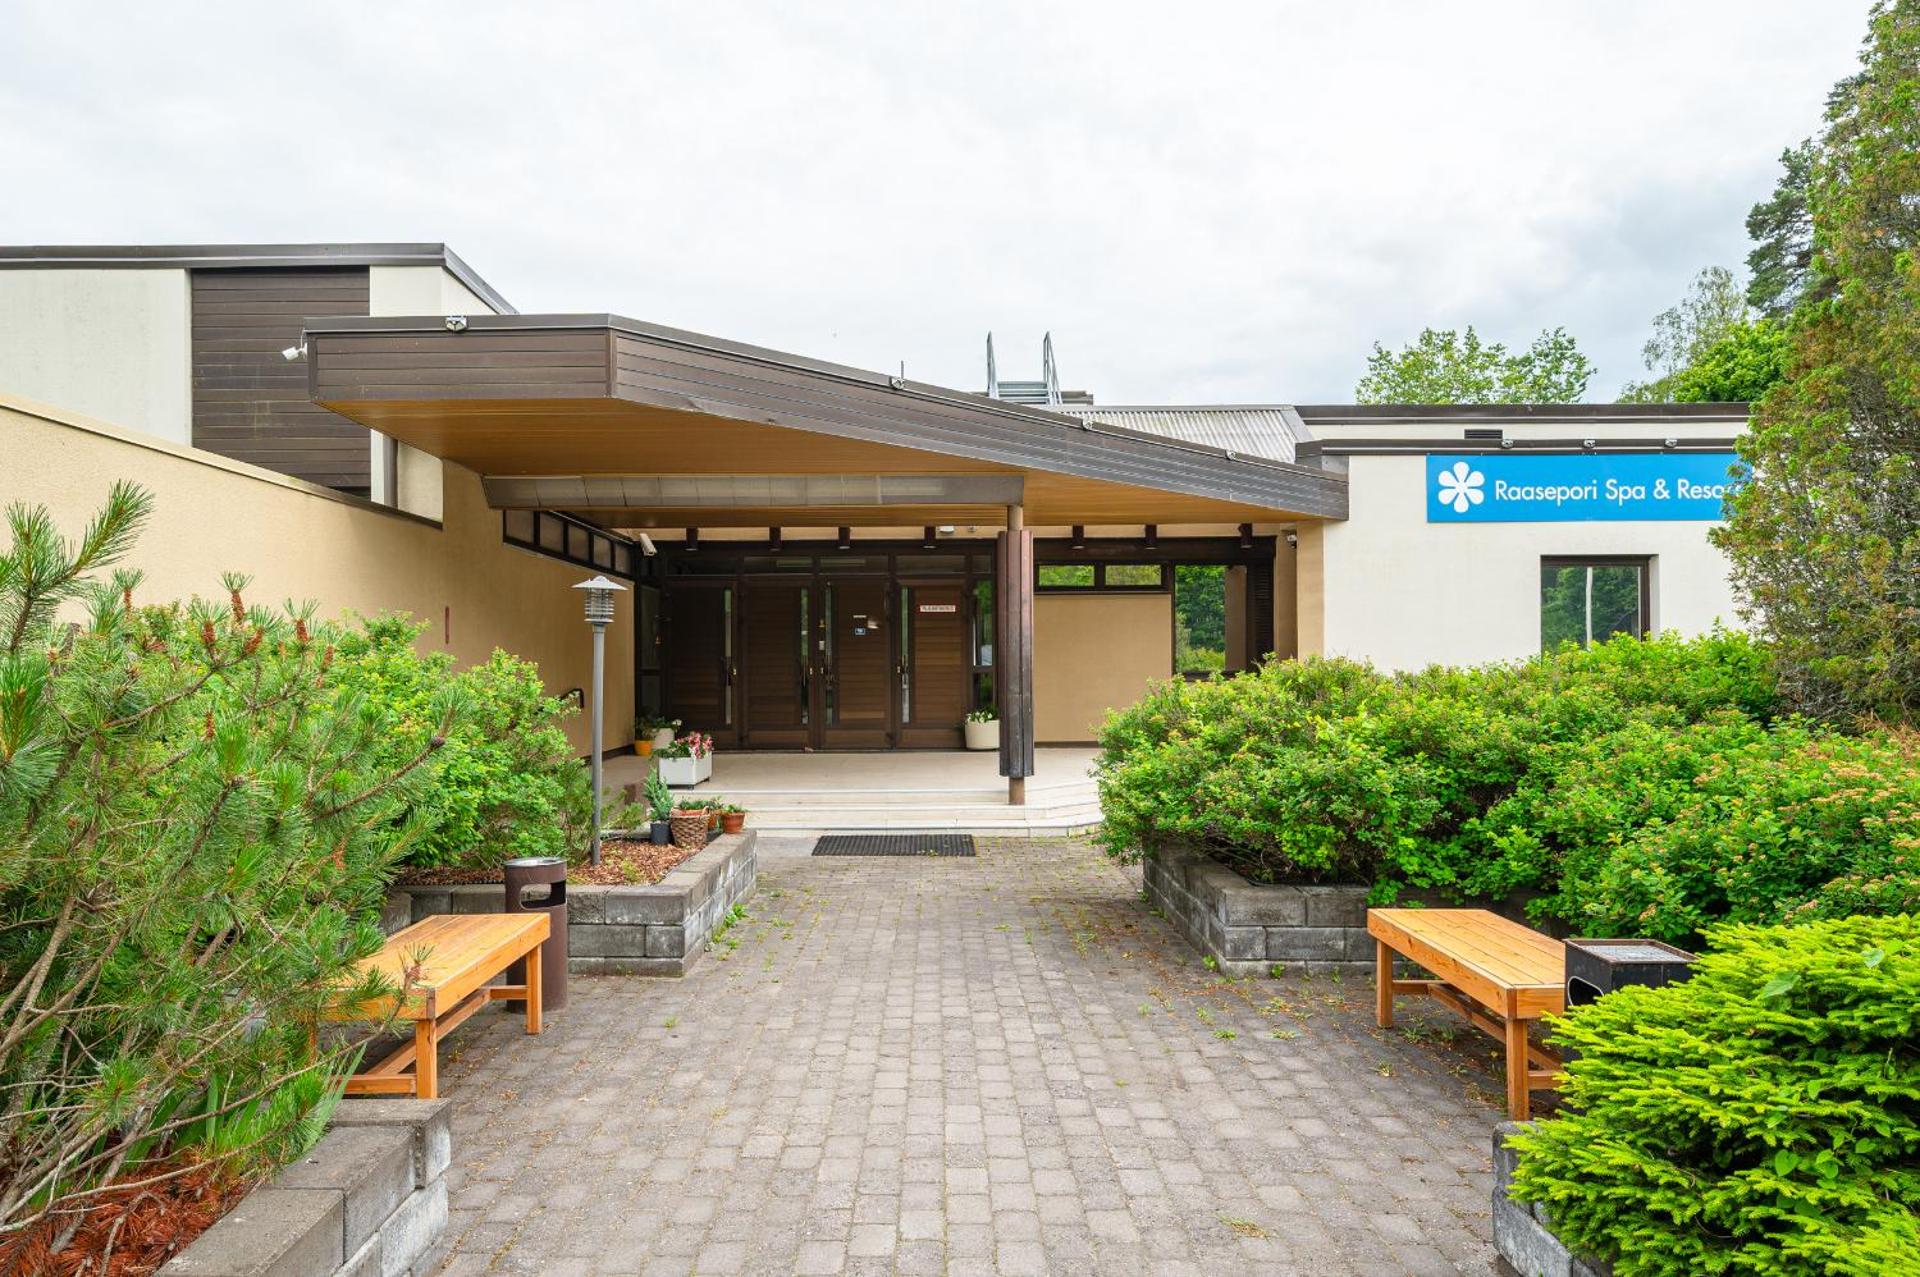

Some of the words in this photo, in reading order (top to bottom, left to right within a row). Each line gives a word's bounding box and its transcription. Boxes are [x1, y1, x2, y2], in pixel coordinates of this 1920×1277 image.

[1495, 480, 1597, 506] Raasepori
[1606, 478, 1646, 506] Spa
[1653, 478, 1671, 500] &
[1677, 478, 1742, 500] Reso
